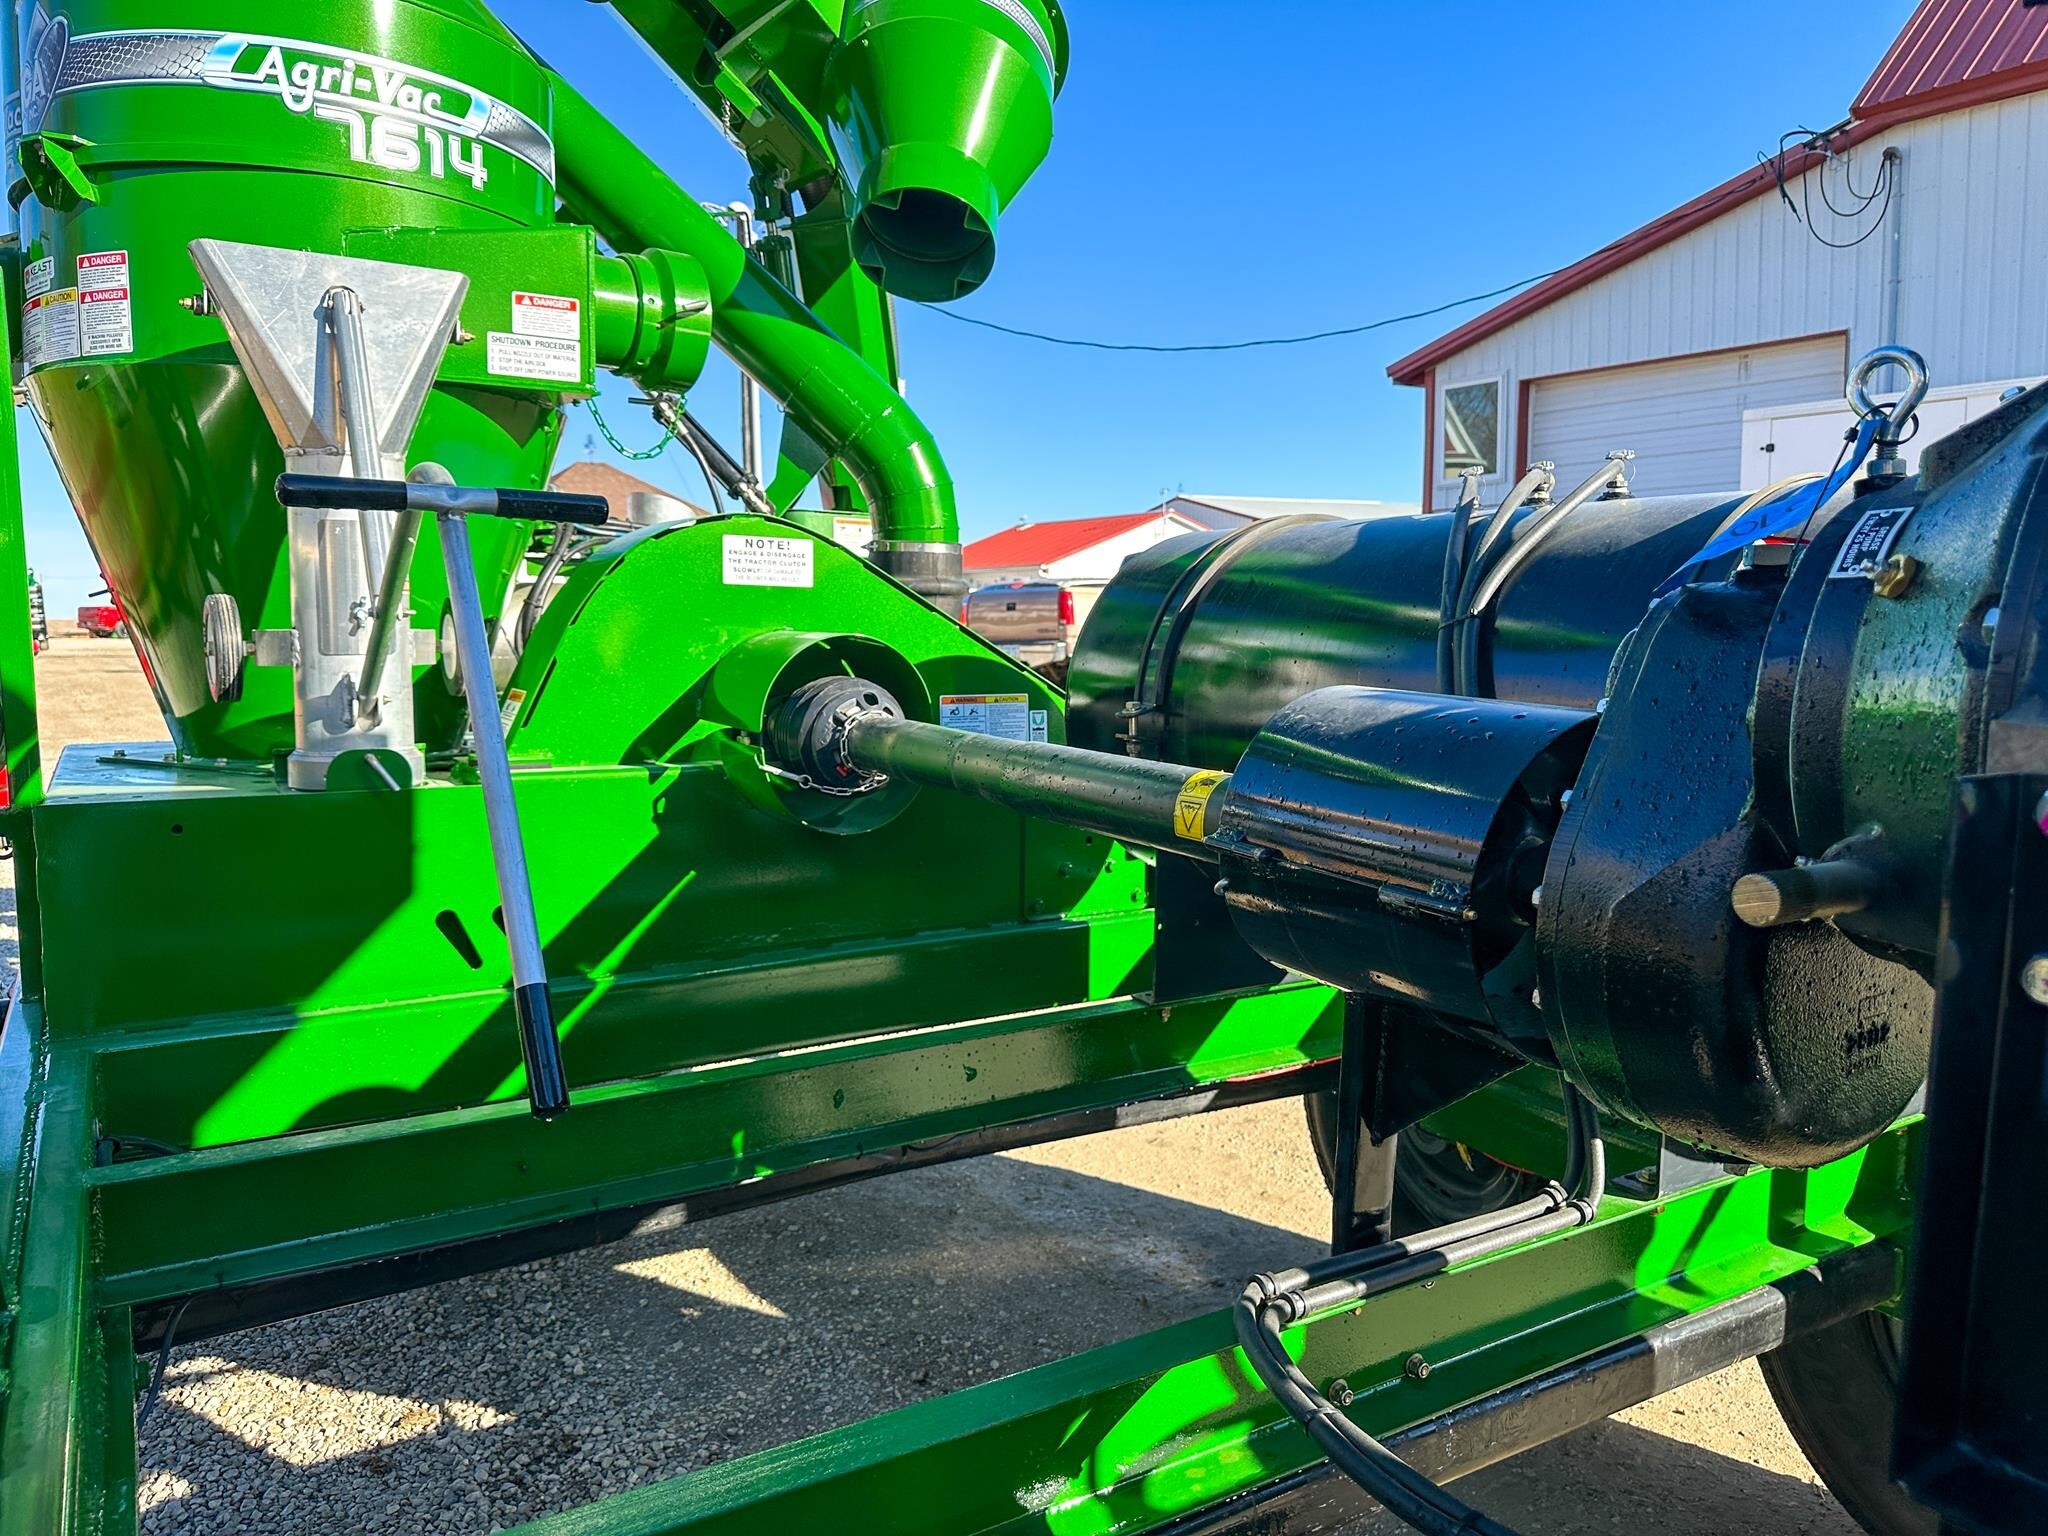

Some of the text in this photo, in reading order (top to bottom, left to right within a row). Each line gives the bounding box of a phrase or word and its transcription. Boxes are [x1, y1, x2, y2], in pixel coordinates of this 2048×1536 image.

[255, 46, 443, 113] Agri-Vac
[314, 102, 488, 191] 7614
[90, 255, 122, 266] DANGER
[50, 292, 72, 304] CAUTION
[93, 290, 124, 300] DANGER
[532, 297, 571, 308] DANGER
[491, 336, 576, 351] SHUTDOWN PROCEDURE
[746, 539, 790, 550] NOTE!
[1854, 534, 1865, 543] 25
[1860, 532, 1876, 551] PUMP
[1869, 526, 1889, 550] GREASE
[1842, 543, 1860, 568] HOURS
